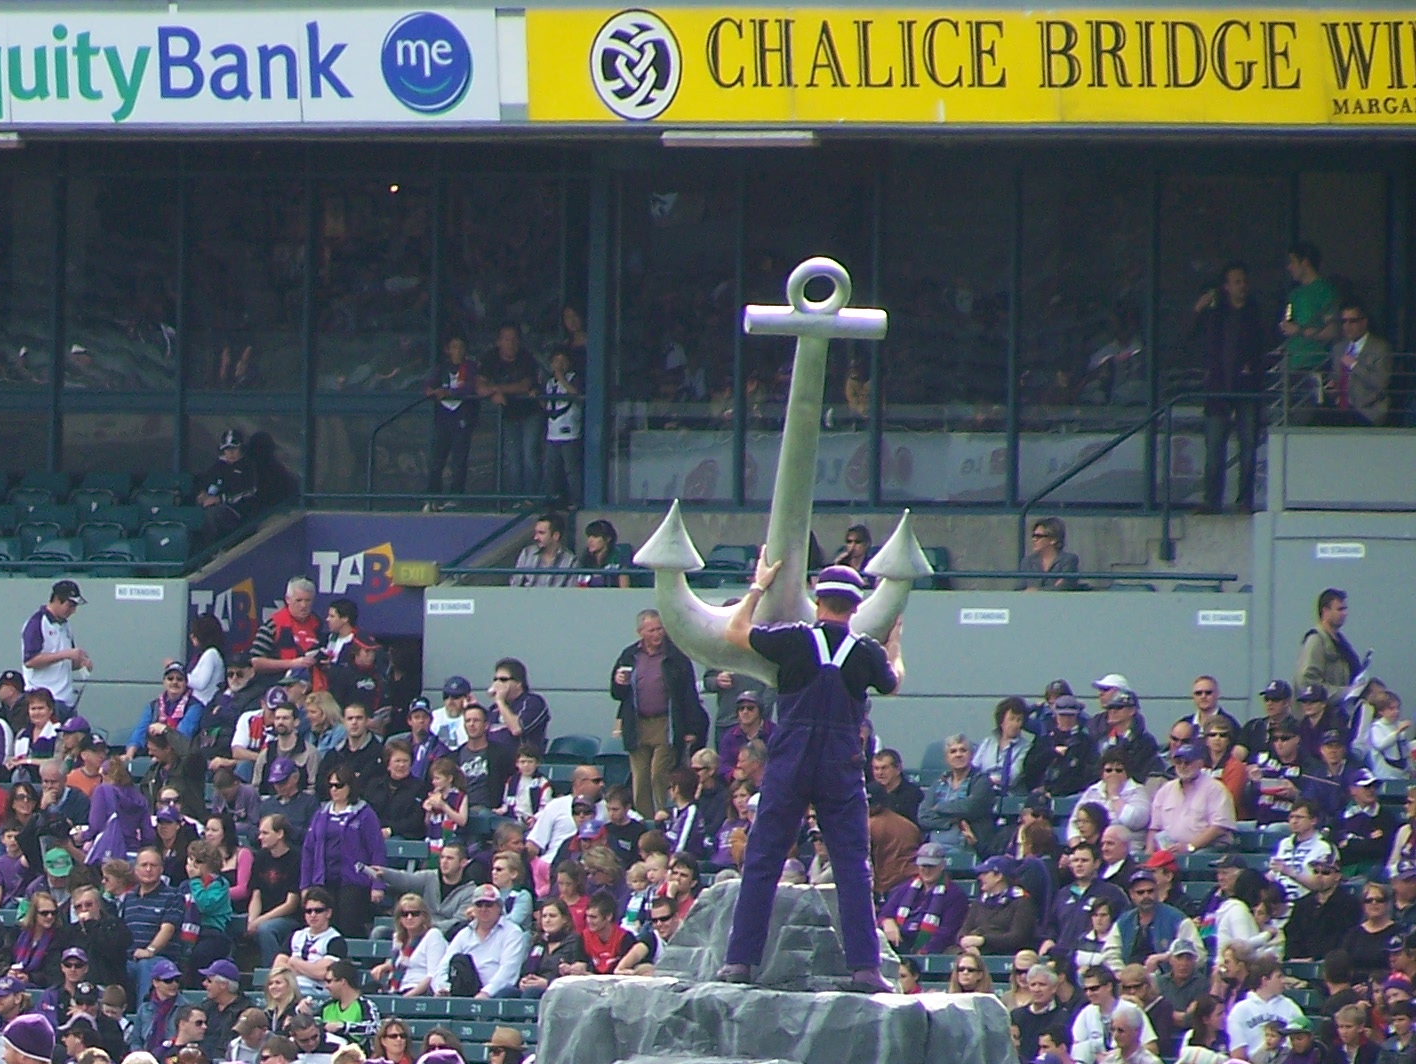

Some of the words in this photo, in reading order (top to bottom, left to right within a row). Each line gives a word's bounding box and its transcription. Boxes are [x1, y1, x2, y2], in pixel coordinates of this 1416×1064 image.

[396, 38, 453, 77] me
[705, 17, 1007, 88] CHALICE
[1037, 20, 1301, 91] BRIDGE
[1332, 97, 1416, 115] MARGA
